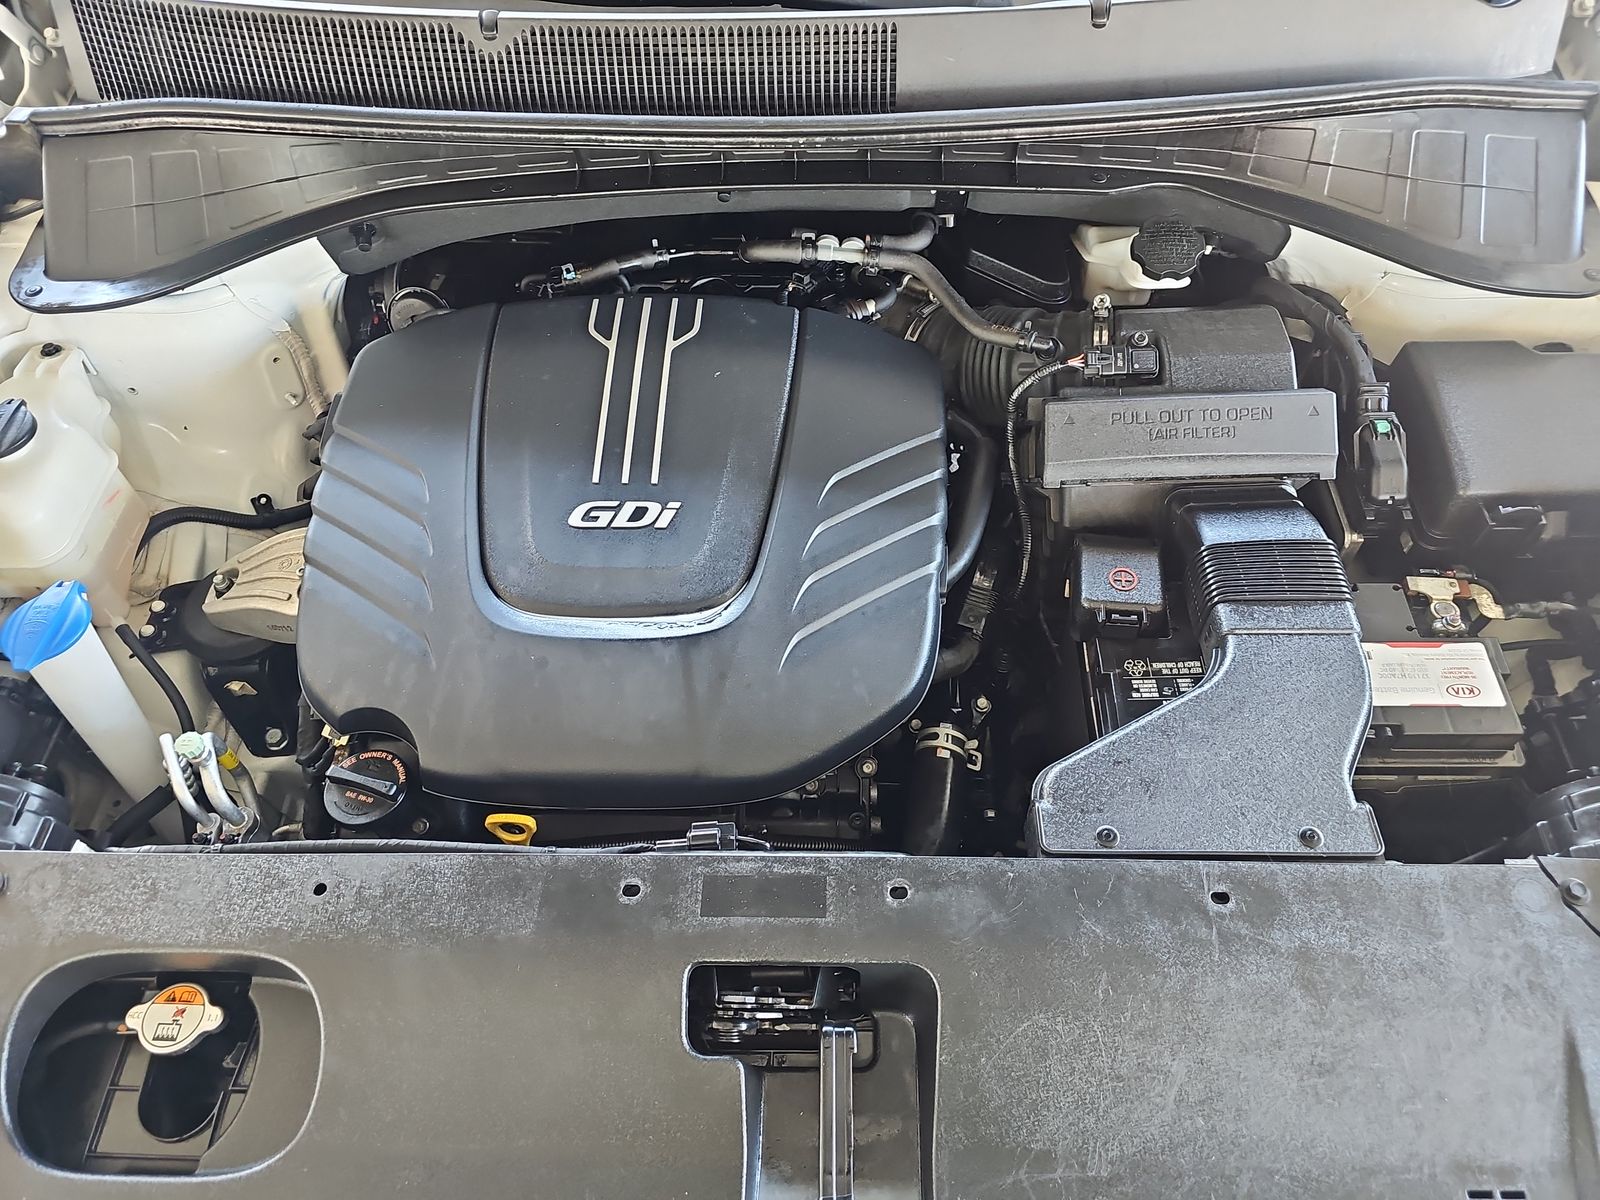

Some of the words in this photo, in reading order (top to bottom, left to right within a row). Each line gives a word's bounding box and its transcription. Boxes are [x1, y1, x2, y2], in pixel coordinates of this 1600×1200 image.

[1110, 409, 1155, 426] PULL
[1159, 408, 1194, 424] OUT
[1199, 407, 1222, 423] TO
[1226, 406, 1273, 422] OPEN
[1148, 427, 1178, 441] (AIR
[1182, 425, 1236, 440] FILTER)
[567, 500, 682, 529] GDi
[1400, 686, 1435, 694] Genuine
[342, 756, 358, 769] SEE
[359, 751, 393, 760] OWNER'S
[392, 758, 408, 785] MANUAL
[345, 790, 357, 798] SAE
[357, 794, 374, 804] 5W-30
